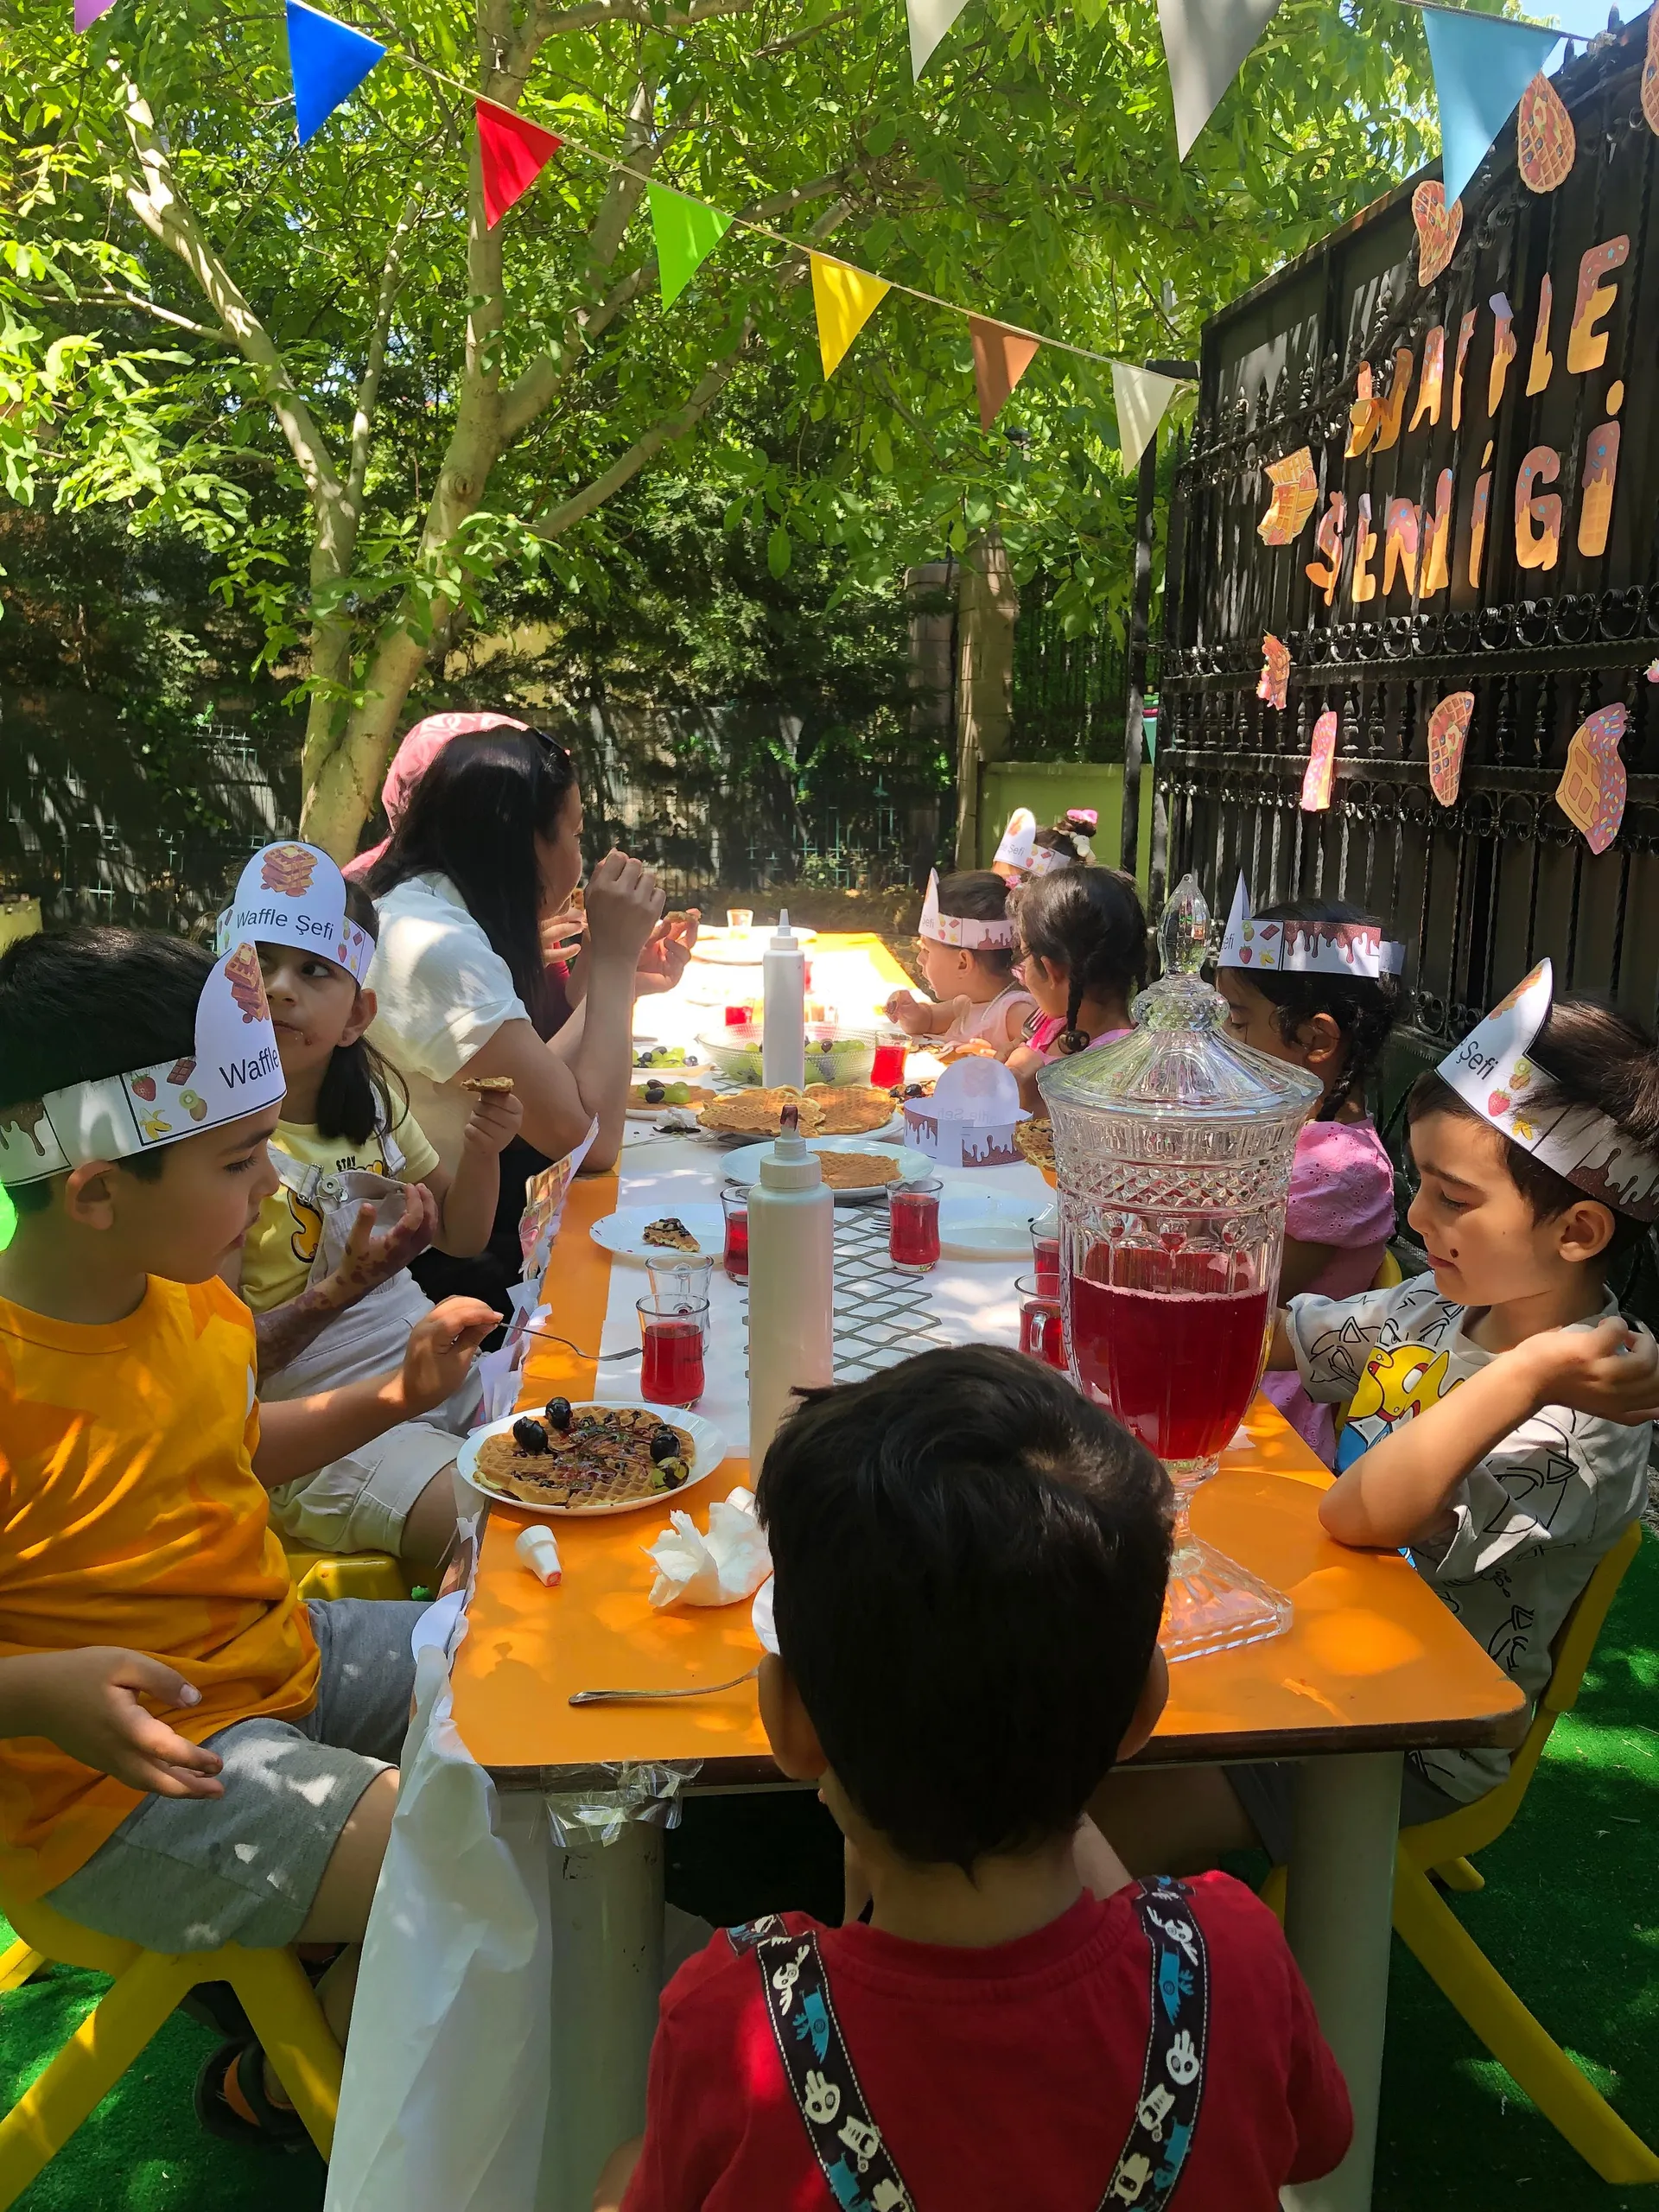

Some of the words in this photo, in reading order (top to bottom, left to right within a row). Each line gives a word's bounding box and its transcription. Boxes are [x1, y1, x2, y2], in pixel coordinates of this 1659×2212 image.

[237, 908, 288, 929] Waffle
[295, 914, 334, 941] Şefi
[219, 1046, 280, 1089] Waffle
[1456, 1040, 1499, 1080] Şefi
[336, 1155, 356, 1172] STAY
